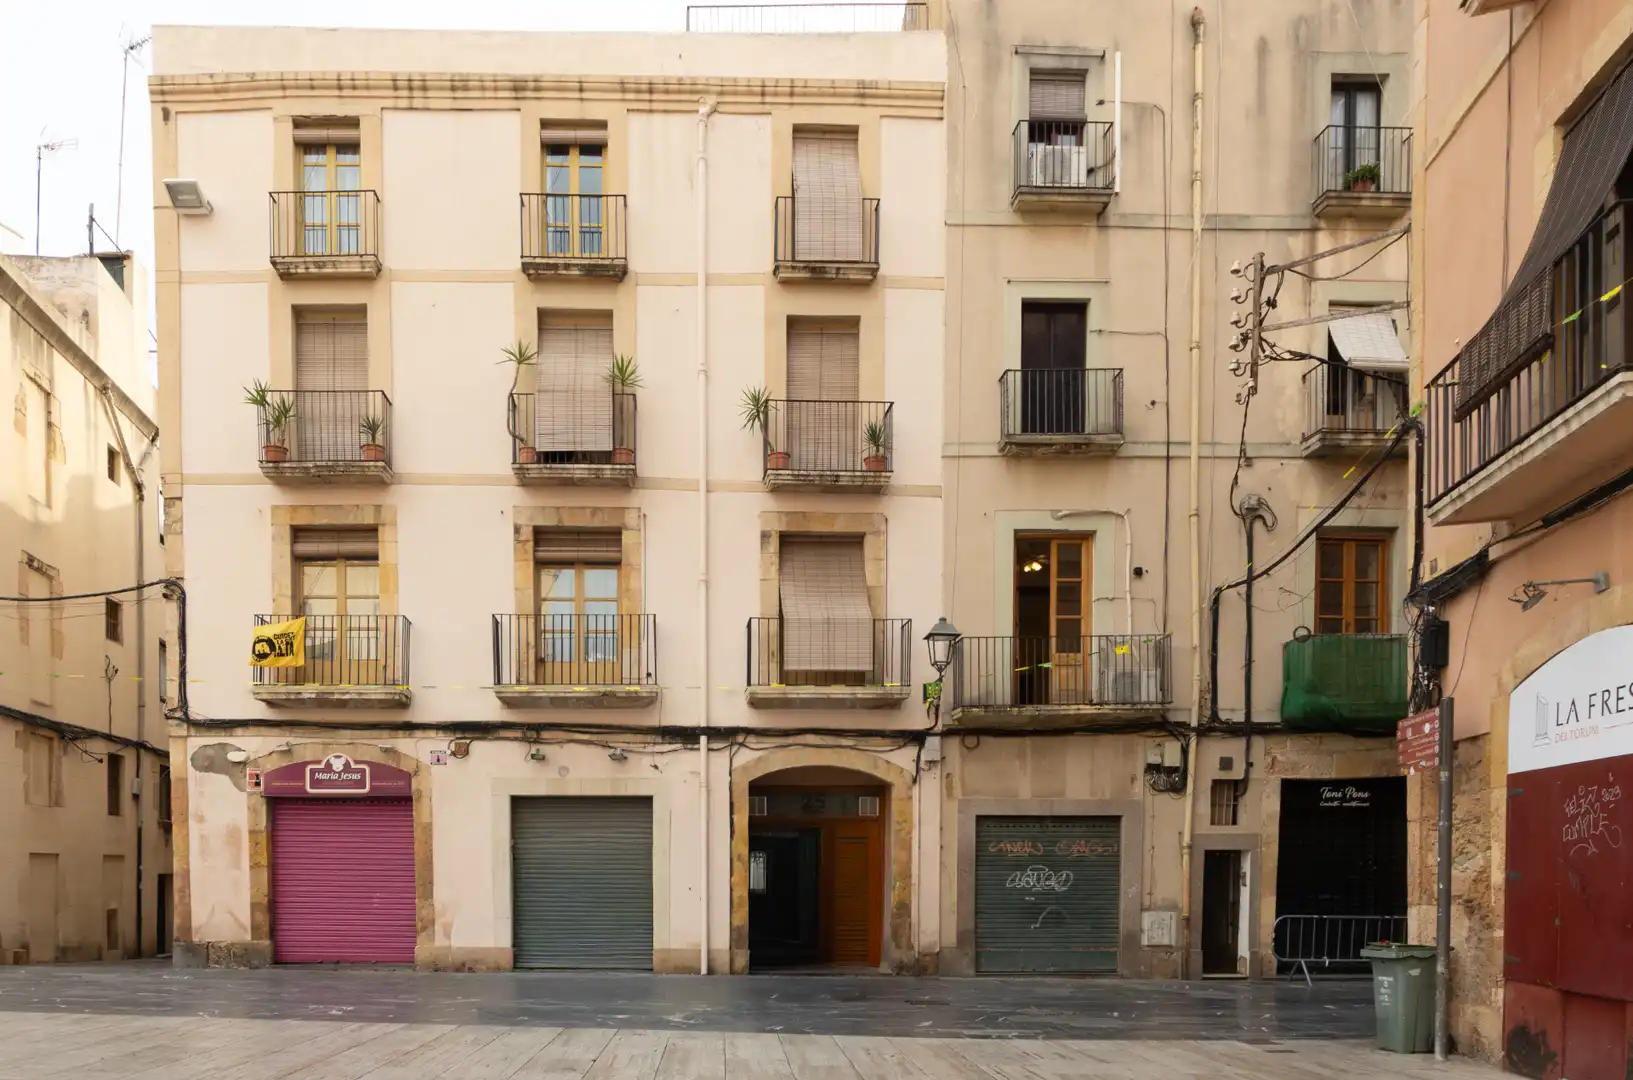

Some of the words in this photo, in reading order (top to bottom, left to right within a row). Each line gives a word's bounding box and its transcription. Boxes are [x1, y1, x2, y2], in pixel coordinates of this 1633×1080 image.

[1556, 697, 1580, 727] LA
[314, 772, 339, 780] Maria
[339, 772, 361, 781] Jesus
[1320, 786, 1343, 800] Toni
[1345, 786, 1371, 800] Pons
[801, 793, 826, 811] 25
